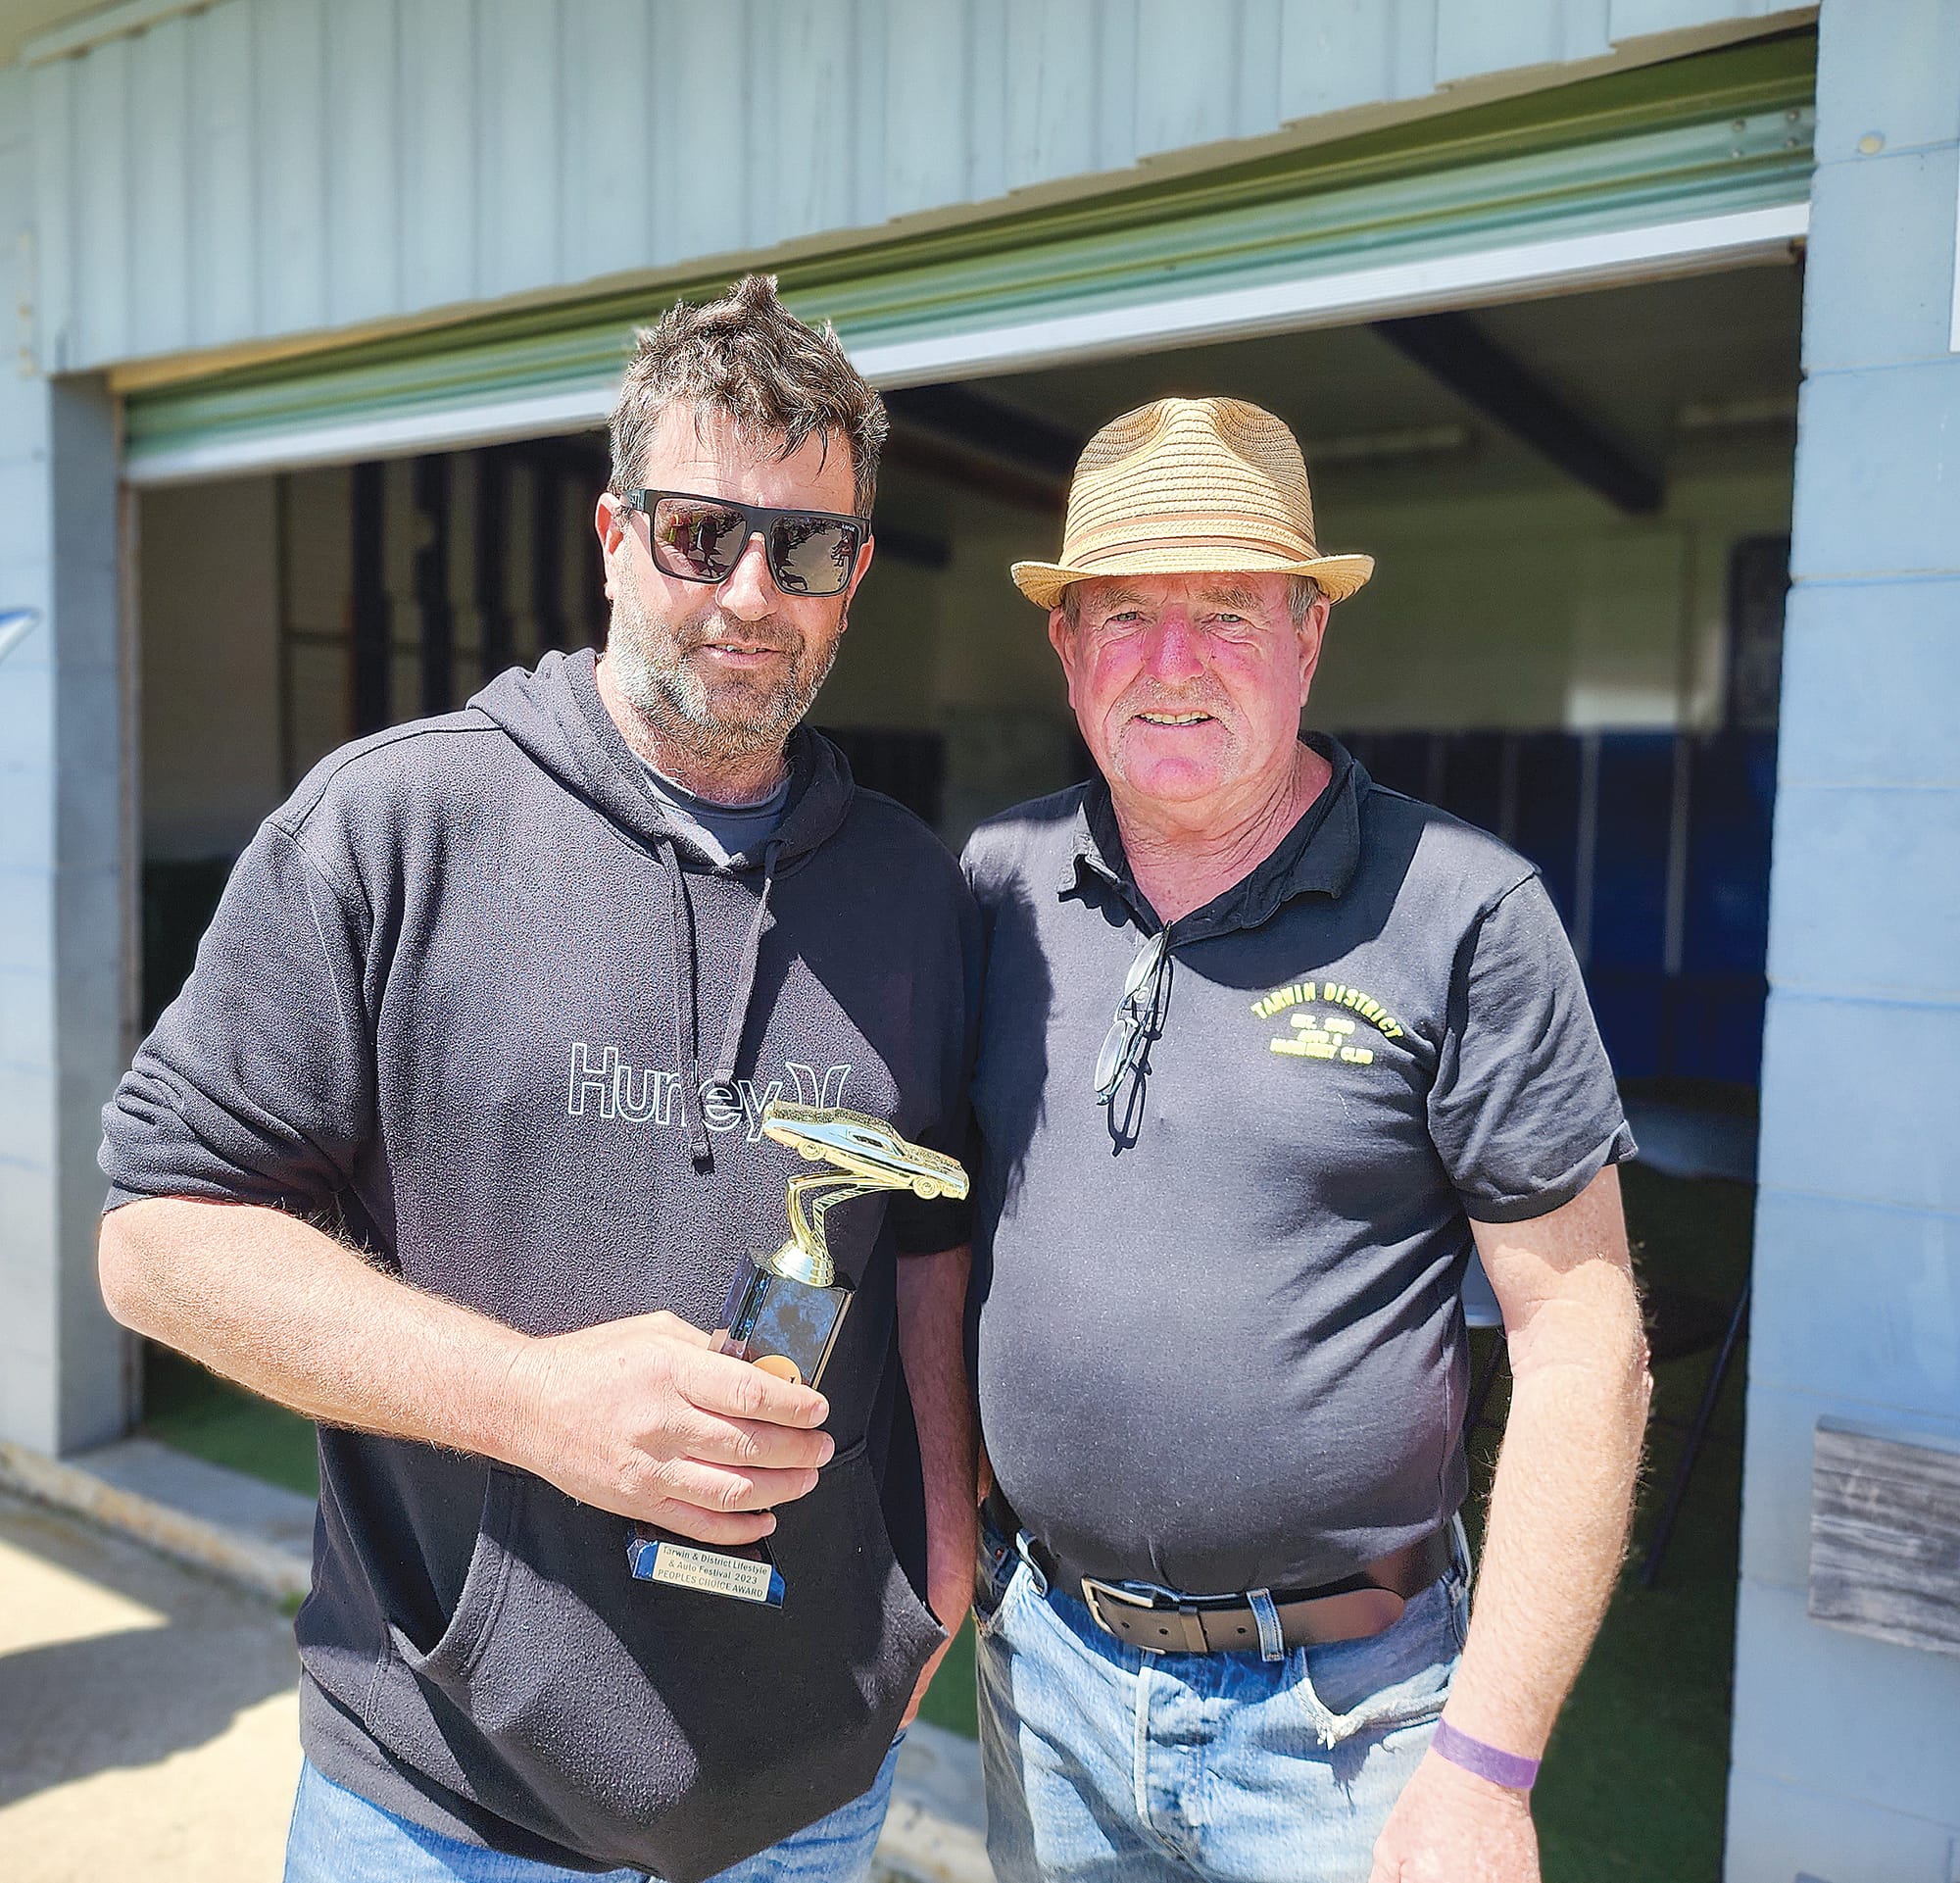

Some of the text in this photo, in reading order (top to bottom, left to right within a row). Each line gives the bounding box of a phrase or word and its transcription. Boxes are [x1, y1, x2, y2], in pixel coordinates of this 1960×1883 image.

[1323, 982, 1404, 1038] DISTRICT
[568, 1042, 783, 1142] Hurey
[662, 1546, 767, 1575] Tarwin & District Lifestyle
[668, 1560, 758, 1585] & Auto Festival 2023
[658, 1568, 763, 1598] PEOPLES CHOICE AWARD
